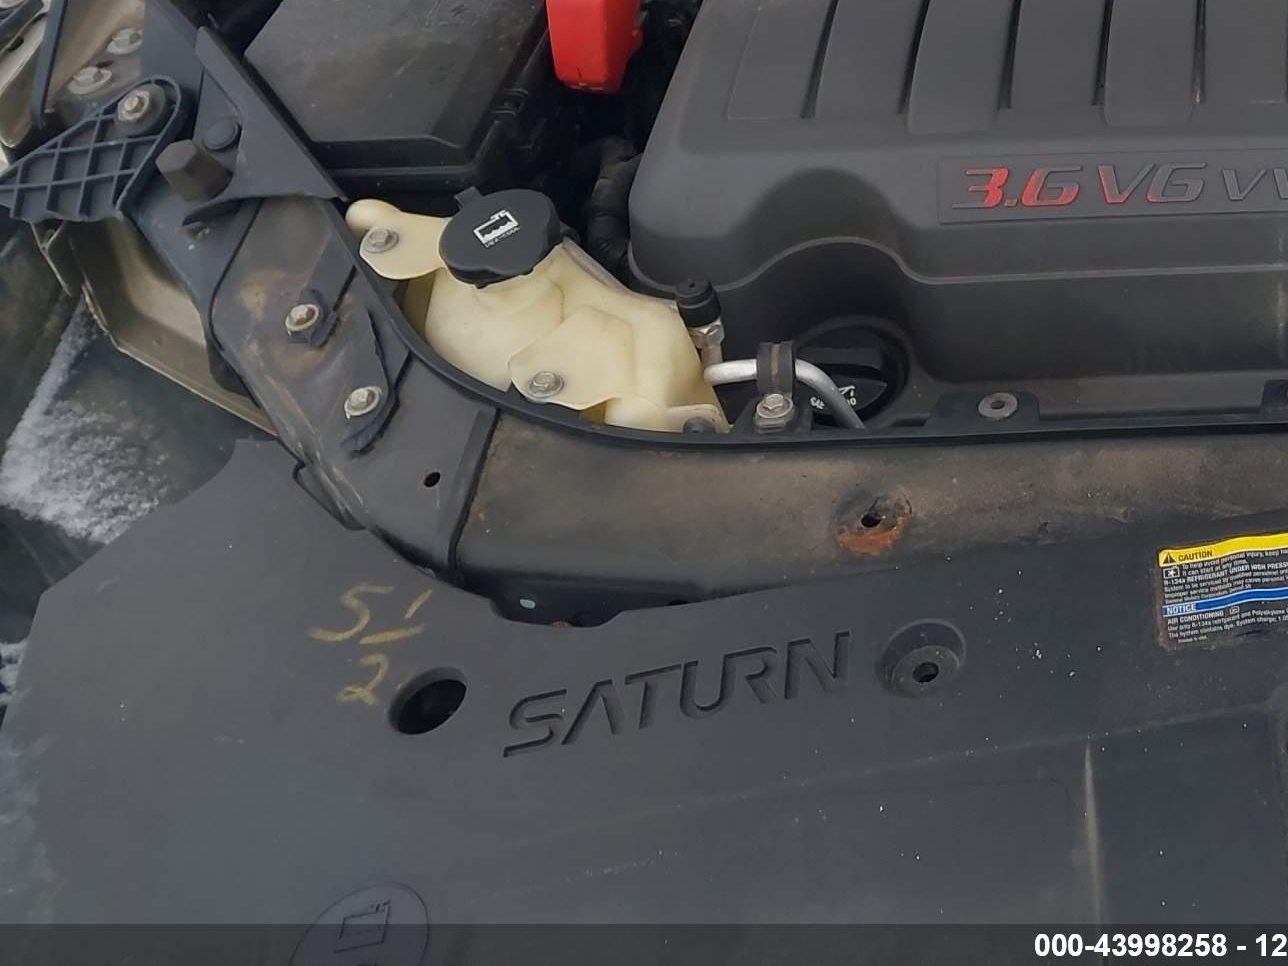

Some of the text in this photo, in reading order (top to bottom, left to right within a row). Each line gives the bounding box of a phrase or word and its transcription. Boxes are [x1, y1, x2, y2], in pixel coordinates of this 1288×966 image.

[951, 166, 1083, 209] 3.6
[1097, 161, 1208, 205] V6
[1178, 550, 1213, 562] CAUTION
[1166, 603, 1196, 614] NOTICE
[503, 631, 850, 758] SATURN
